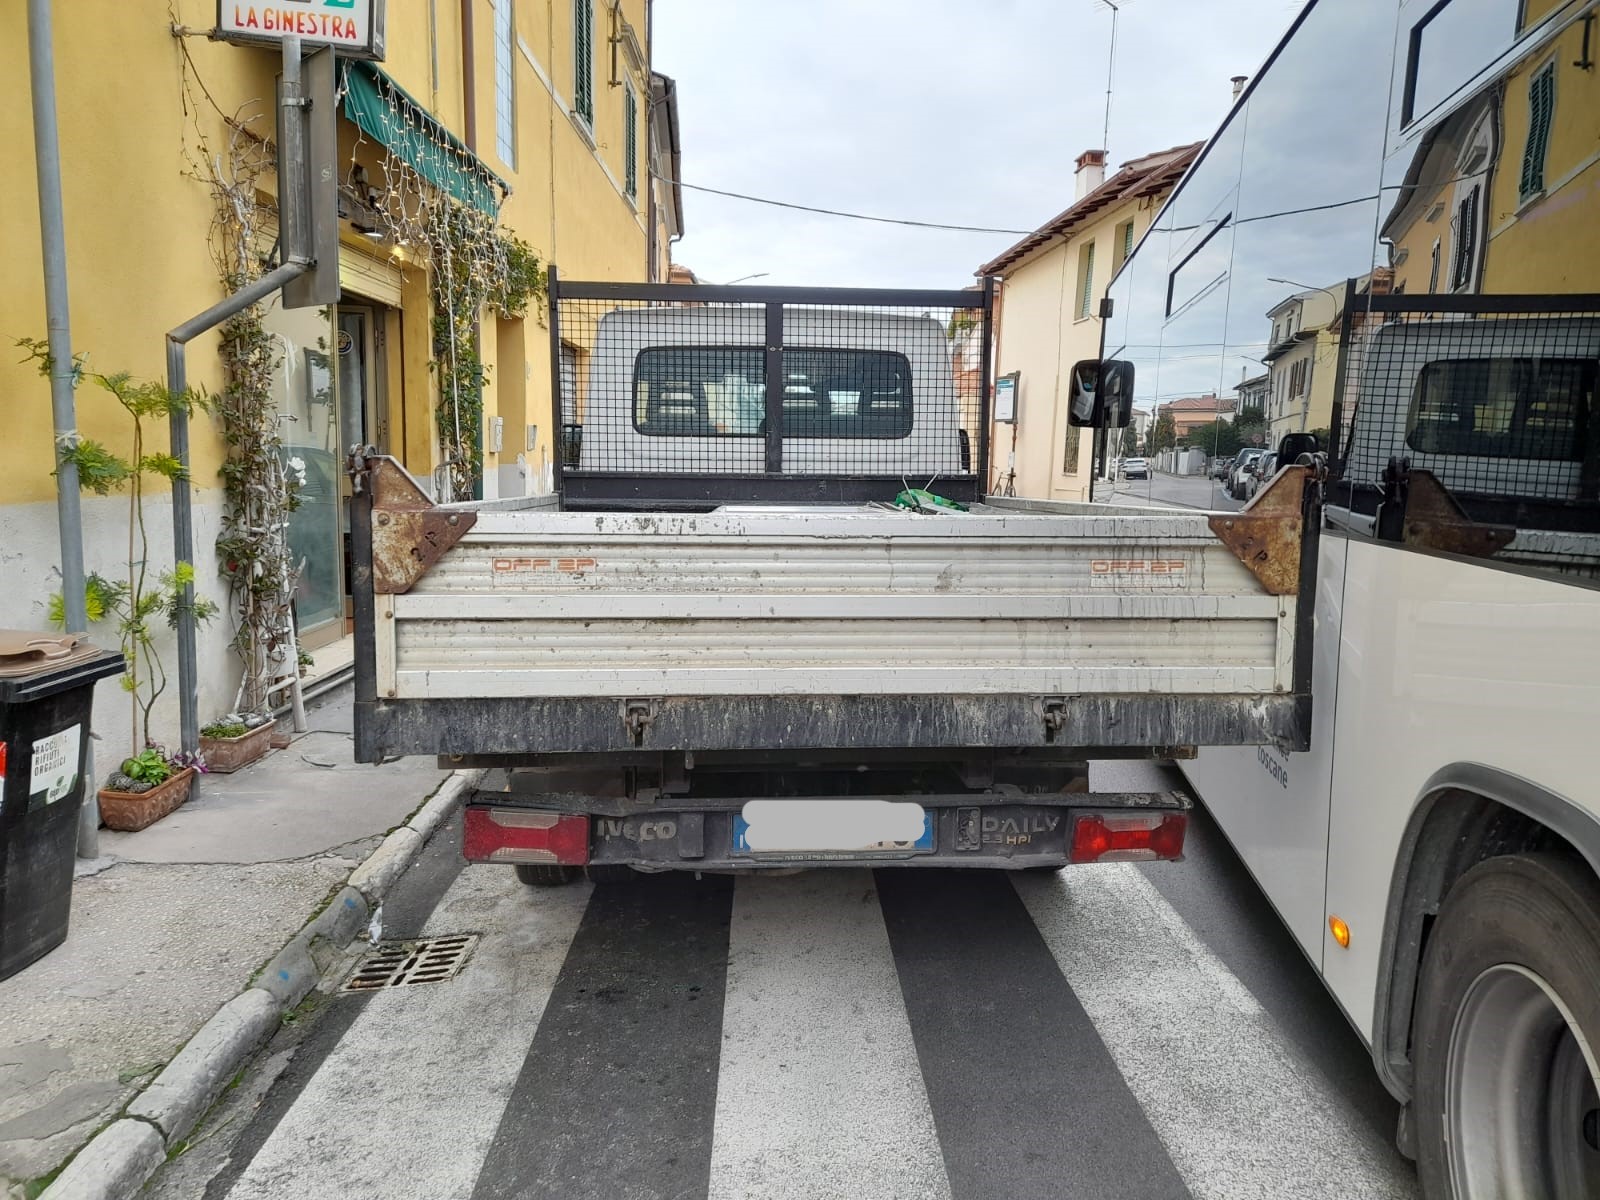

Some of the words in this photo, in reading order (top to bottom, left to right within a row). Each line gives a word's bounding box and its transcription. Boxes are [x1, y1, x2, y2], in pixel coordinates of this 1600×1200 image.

[235, 5, 258, 29] LA
[263, 8, 357, 39] GINESTRA
[1257, 745, 1288, 789] toscane
[597, 818, 677, 842] IVECO
[982, 816, 1061, 834] DAILY
[1006, 834, 1032, 846] HPI
